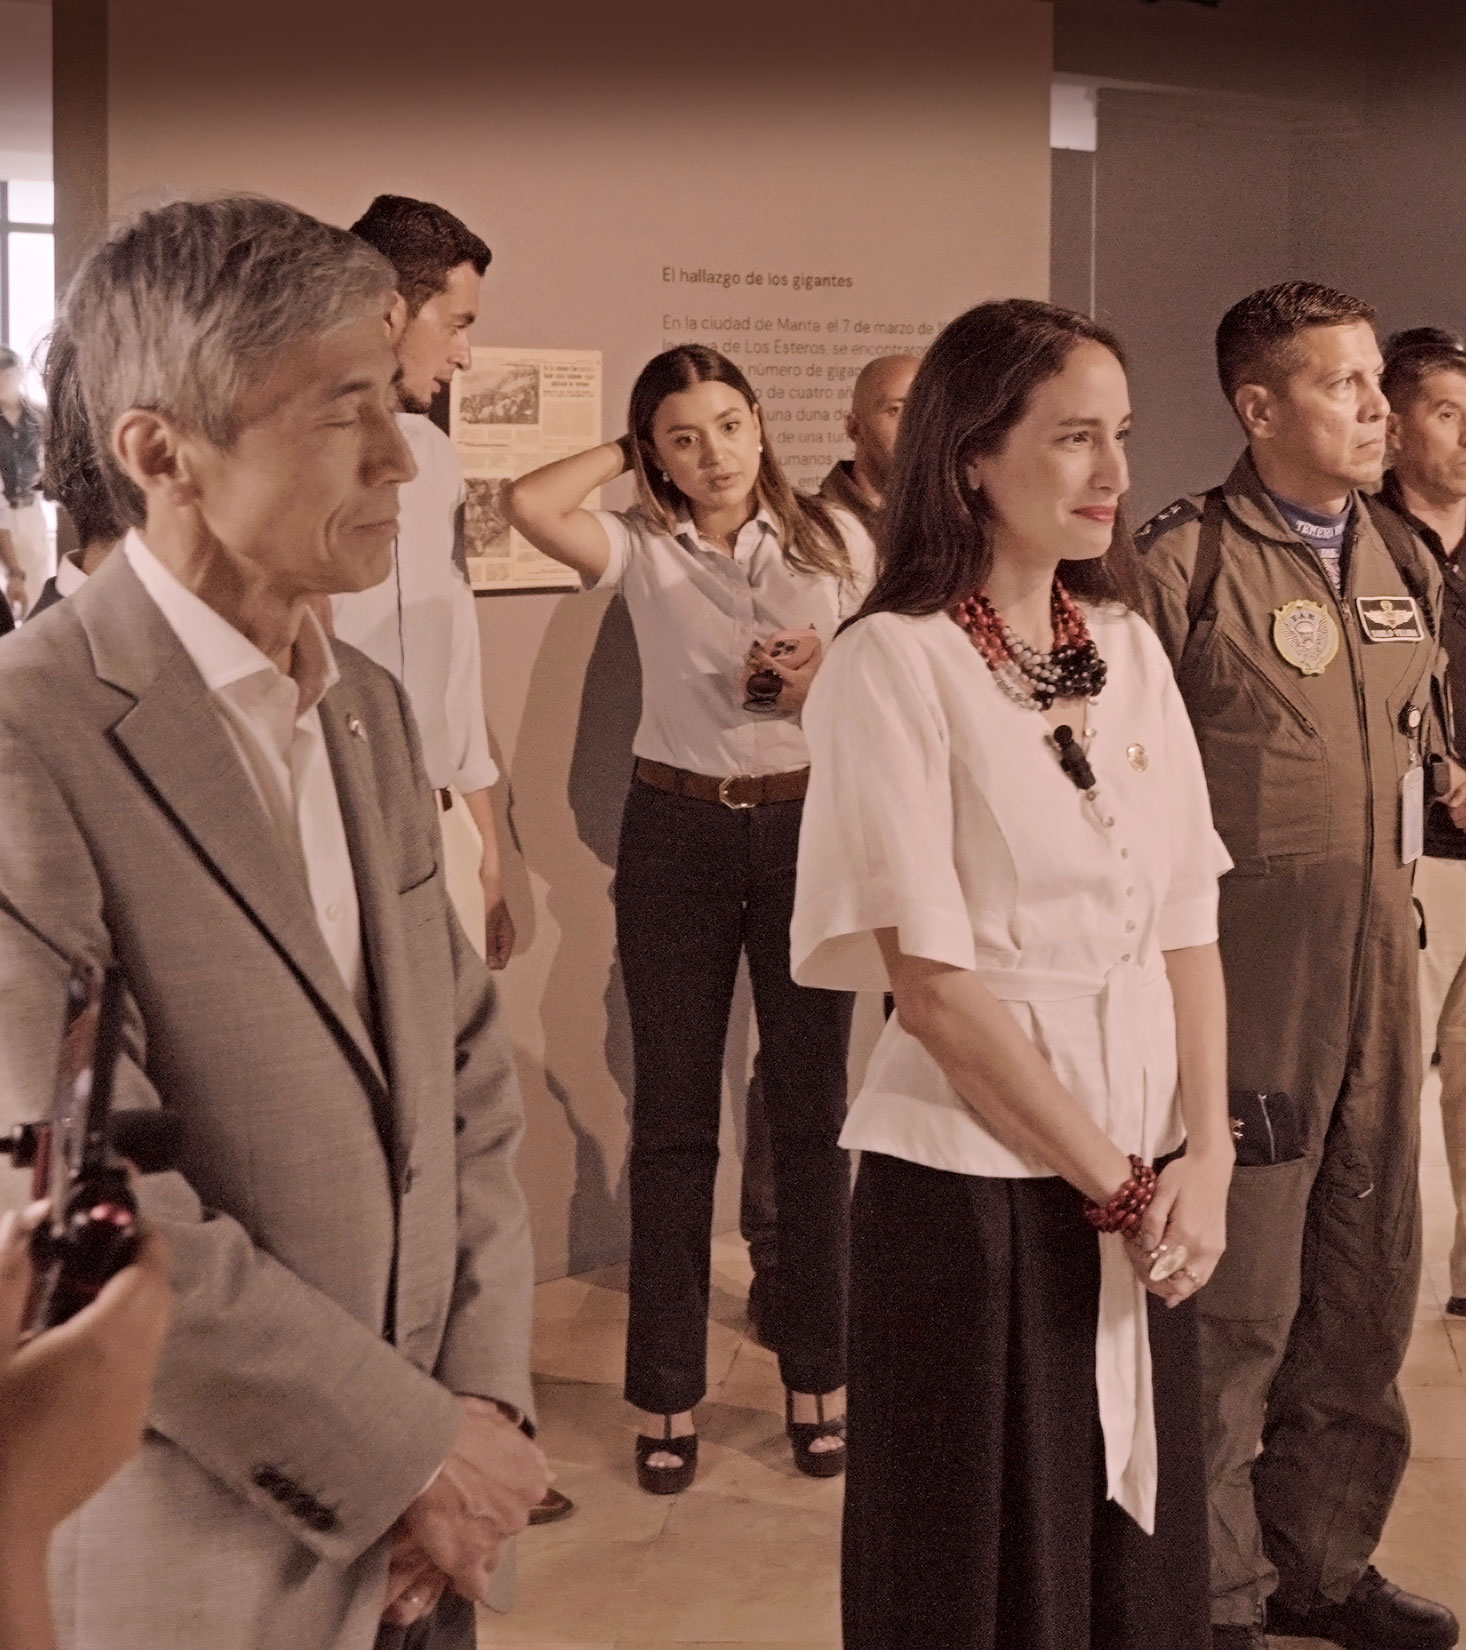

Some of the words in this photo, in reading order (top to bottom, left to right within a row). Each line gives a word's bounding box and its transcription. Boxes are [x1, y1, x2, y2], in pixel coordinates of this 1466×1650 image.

[662, 267, 676, 282] El
[680, 268, 741, 288] hallazgo
[745, 271, 763, 285] de
[767, 272, 789, 286] los
[792, 273, 853, 290] gigantes
[662, 314, 681, 330] En
[685, 315, 698, 330] la
[701, 315, 751, 330] ciudad
[754, 317, 773, 331] de
[827, 318, 839, 333] el
[842, 318, 850, 332] 7
[854, 320, 870, 333] de
[874, 322, 914, 335] marzo
[917, 320, 935, 335] de
[722, 339, 741, 353] de
[745, 339, 770, 354] Los
[833, 343, 848, 355] se
[747, 362, 802, 376] número
[806, 362, 823, 377] de
[827, 363, 862, 381] gigan
[766, 384, 785, 399] de
[788, 386, 833, 399] cuatro
[766, 408, 792, 421] una
[796, 407, 830, 421] duna
[777, 429, 795, 443] de
[798, 430, 823, 443] una
[778, 454, 833, 466] umanos
